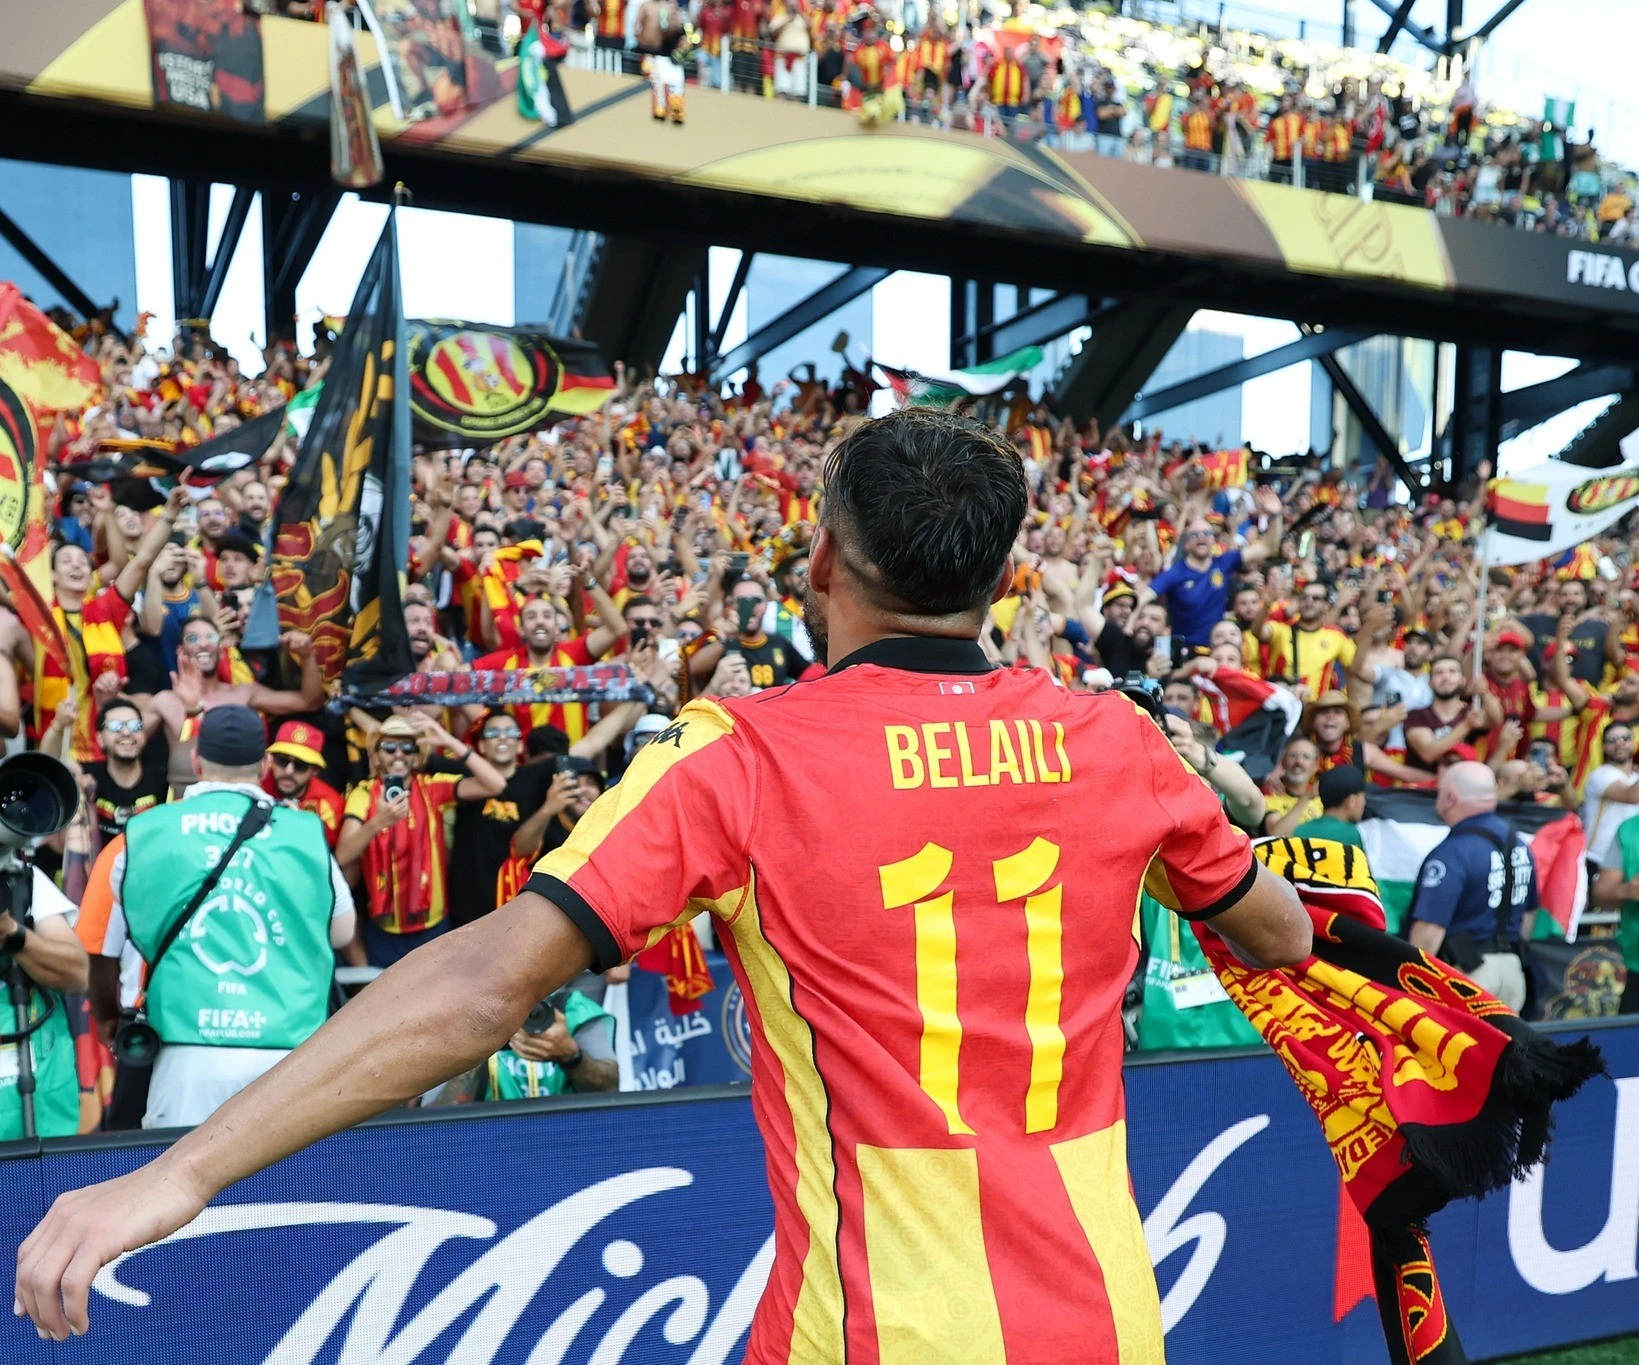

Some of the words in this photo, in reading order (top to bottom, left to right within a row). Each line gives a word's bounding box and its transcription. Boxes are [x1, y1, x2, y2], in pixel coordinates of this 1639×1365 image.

[1566, 249, 1628, 291] FIFA
[884, 719, 1073, 790] BELAILI
[181, 812, 272, 839] PHO
[208, 877, 266, 906] ORLD
[266, 909, 286, 947] CUP
[217, 981, 247, 995] FIFA
[877, 835, 1068, 1136] 11
